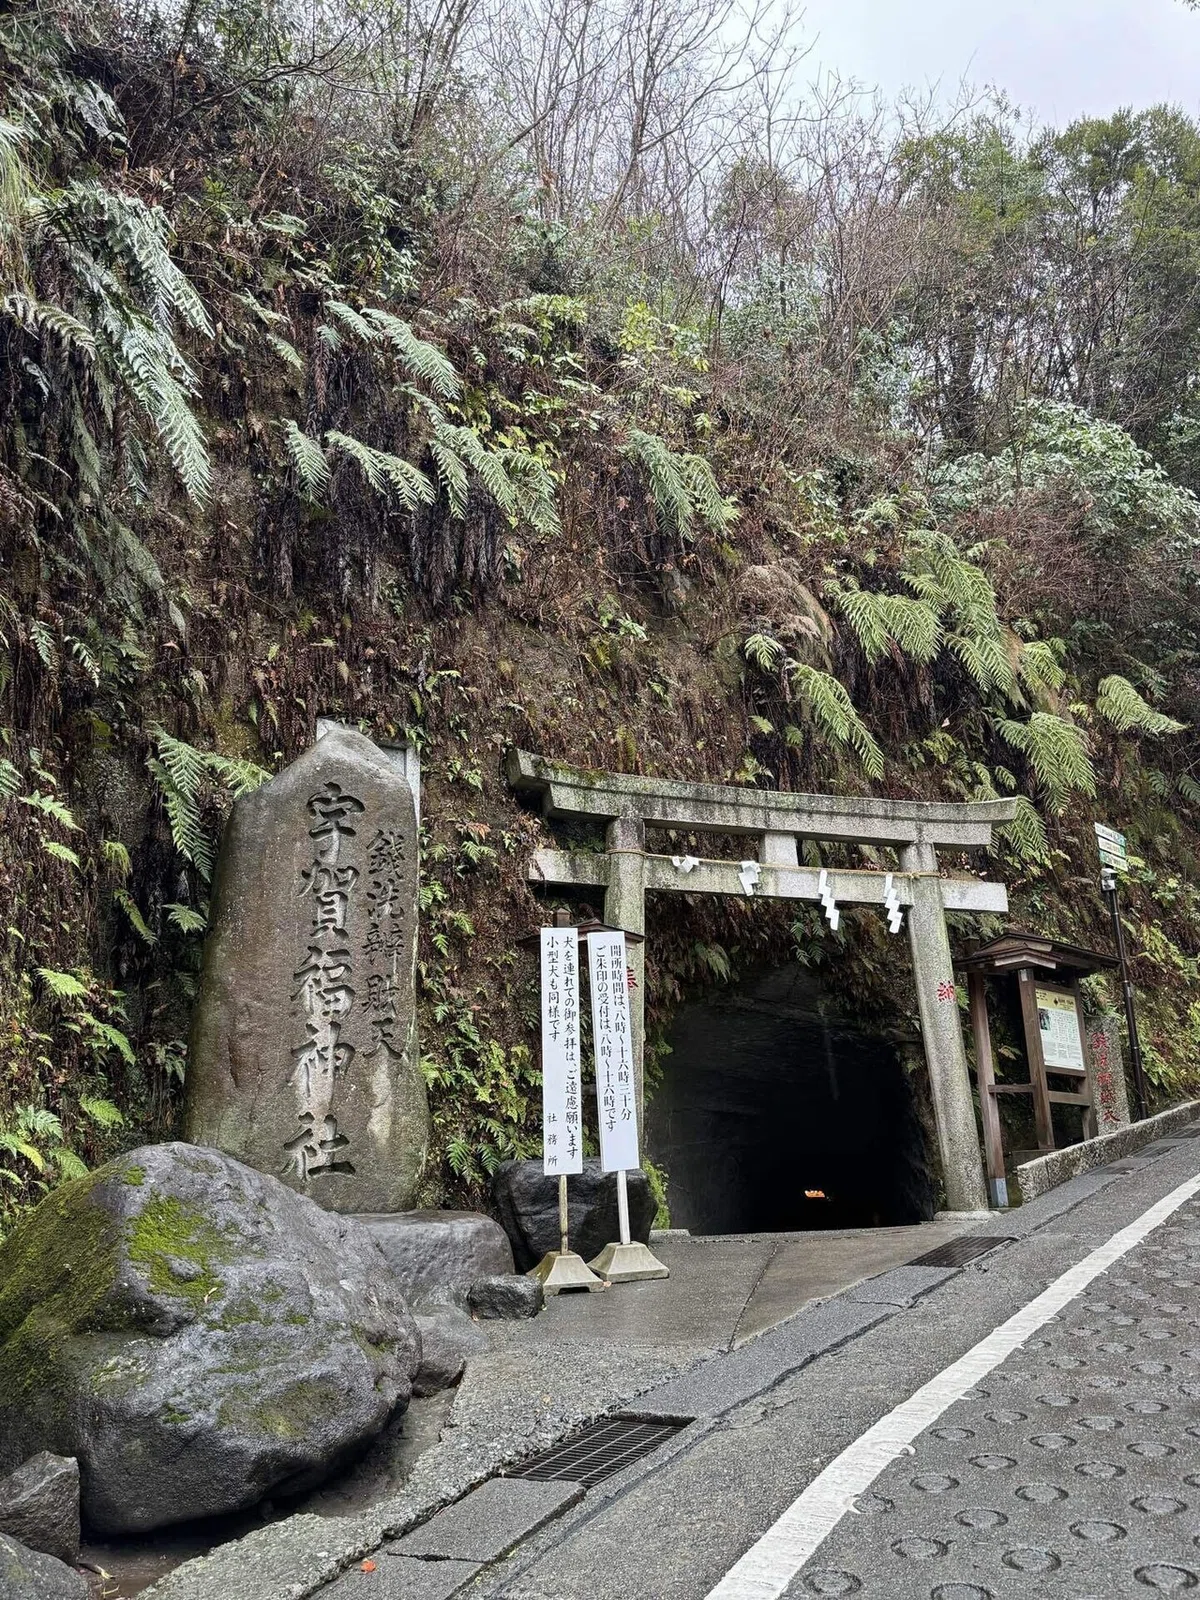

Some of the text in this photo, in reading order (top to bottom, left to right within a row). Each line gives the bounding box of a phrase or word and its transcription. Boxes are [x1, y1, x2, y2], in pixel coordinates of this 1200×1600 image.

[281, 782, 366, 1181] 宇賀福神社
[547, 936, 561, 1042] 小型犬も同様です
[563, 936, 579, 1160] 犬を連れての御参拝は、ご遠慮願います
[547, 1113, 558, 1167] 社務所
